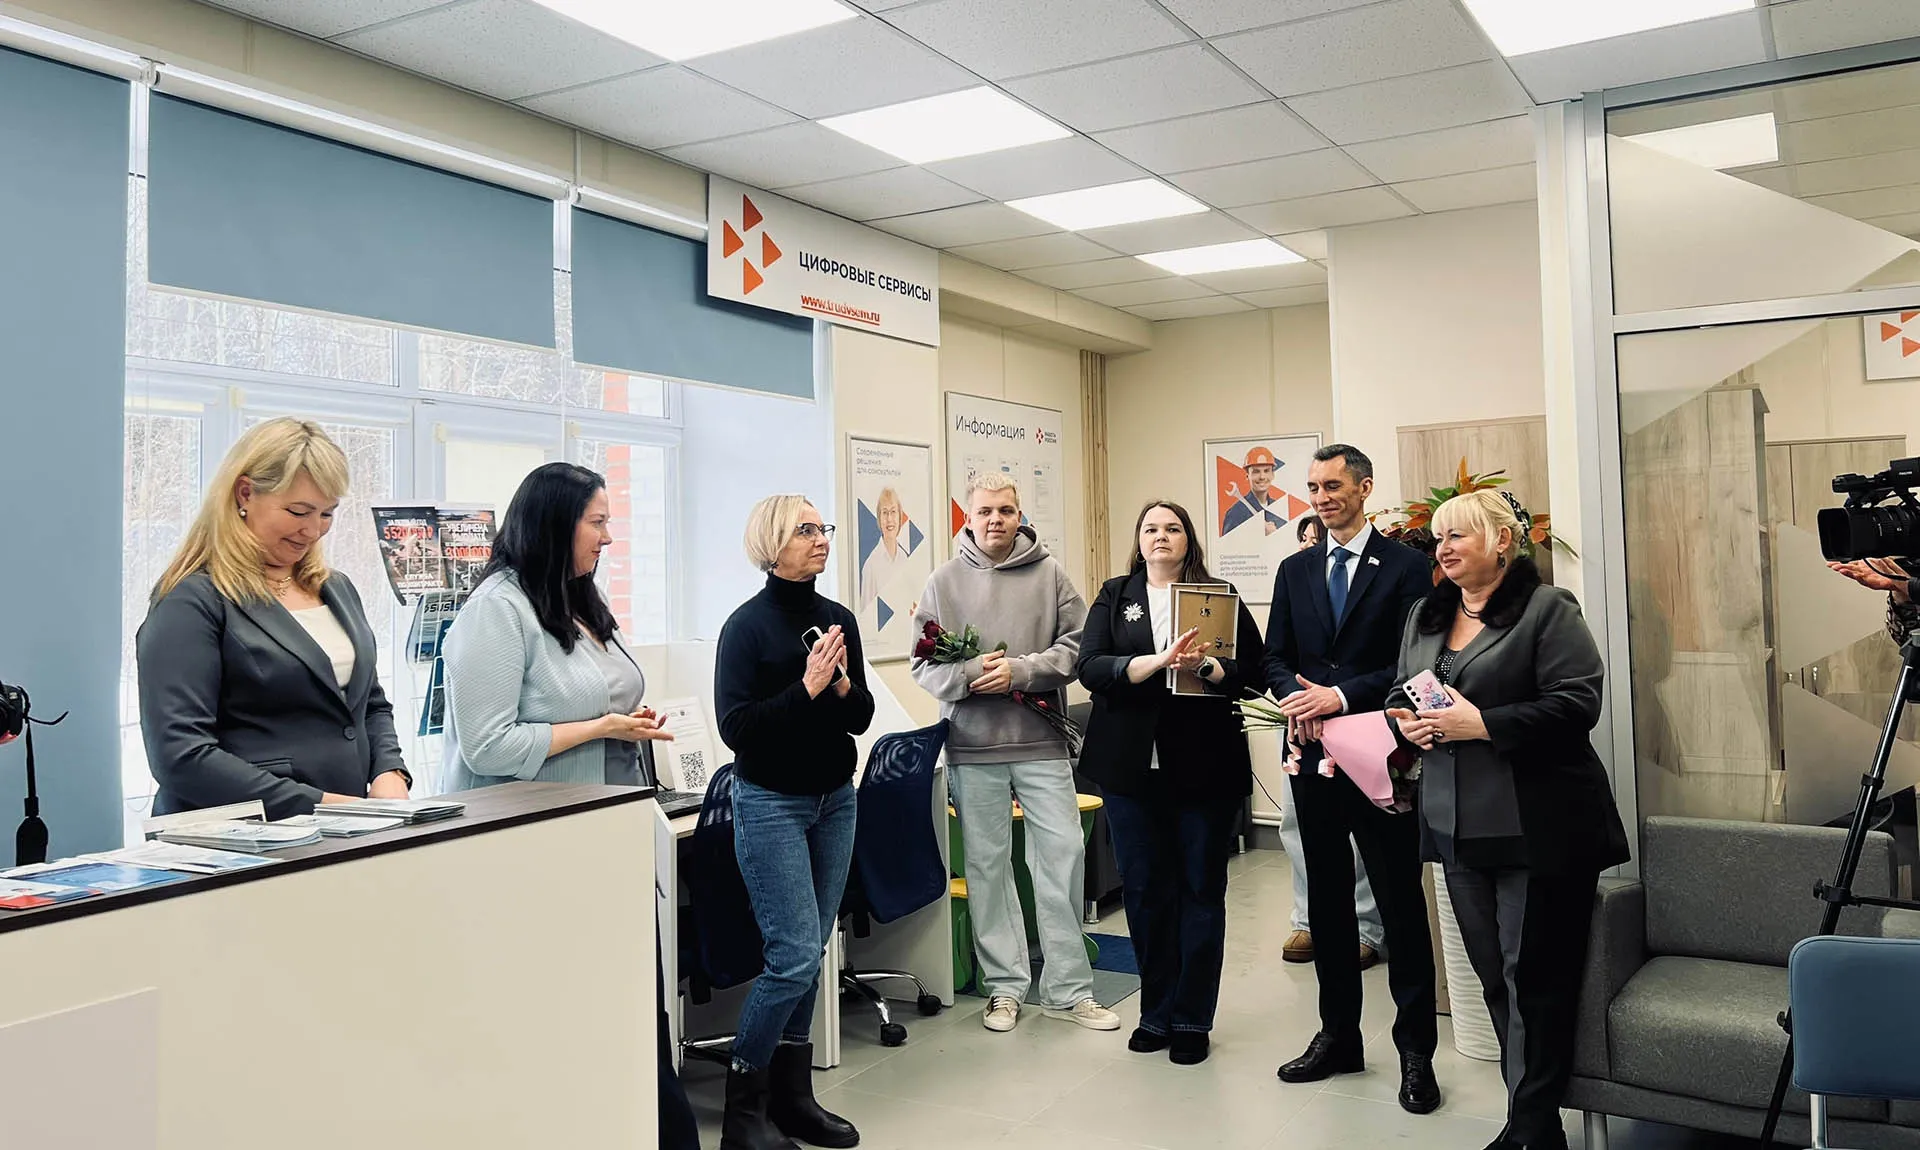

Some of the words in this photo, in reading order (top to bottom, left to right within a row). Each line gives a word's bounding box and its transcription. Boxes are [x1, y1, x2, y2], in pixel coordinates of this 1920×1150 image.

[799, 251, 875, 287] ЦИФРОВЫЕ
[878, 274, 931, 302] СЕРВИСЫ
[801, 295, 880, 323] www.trudvsem.ru
[955, 415, 1025, 440] Информация
